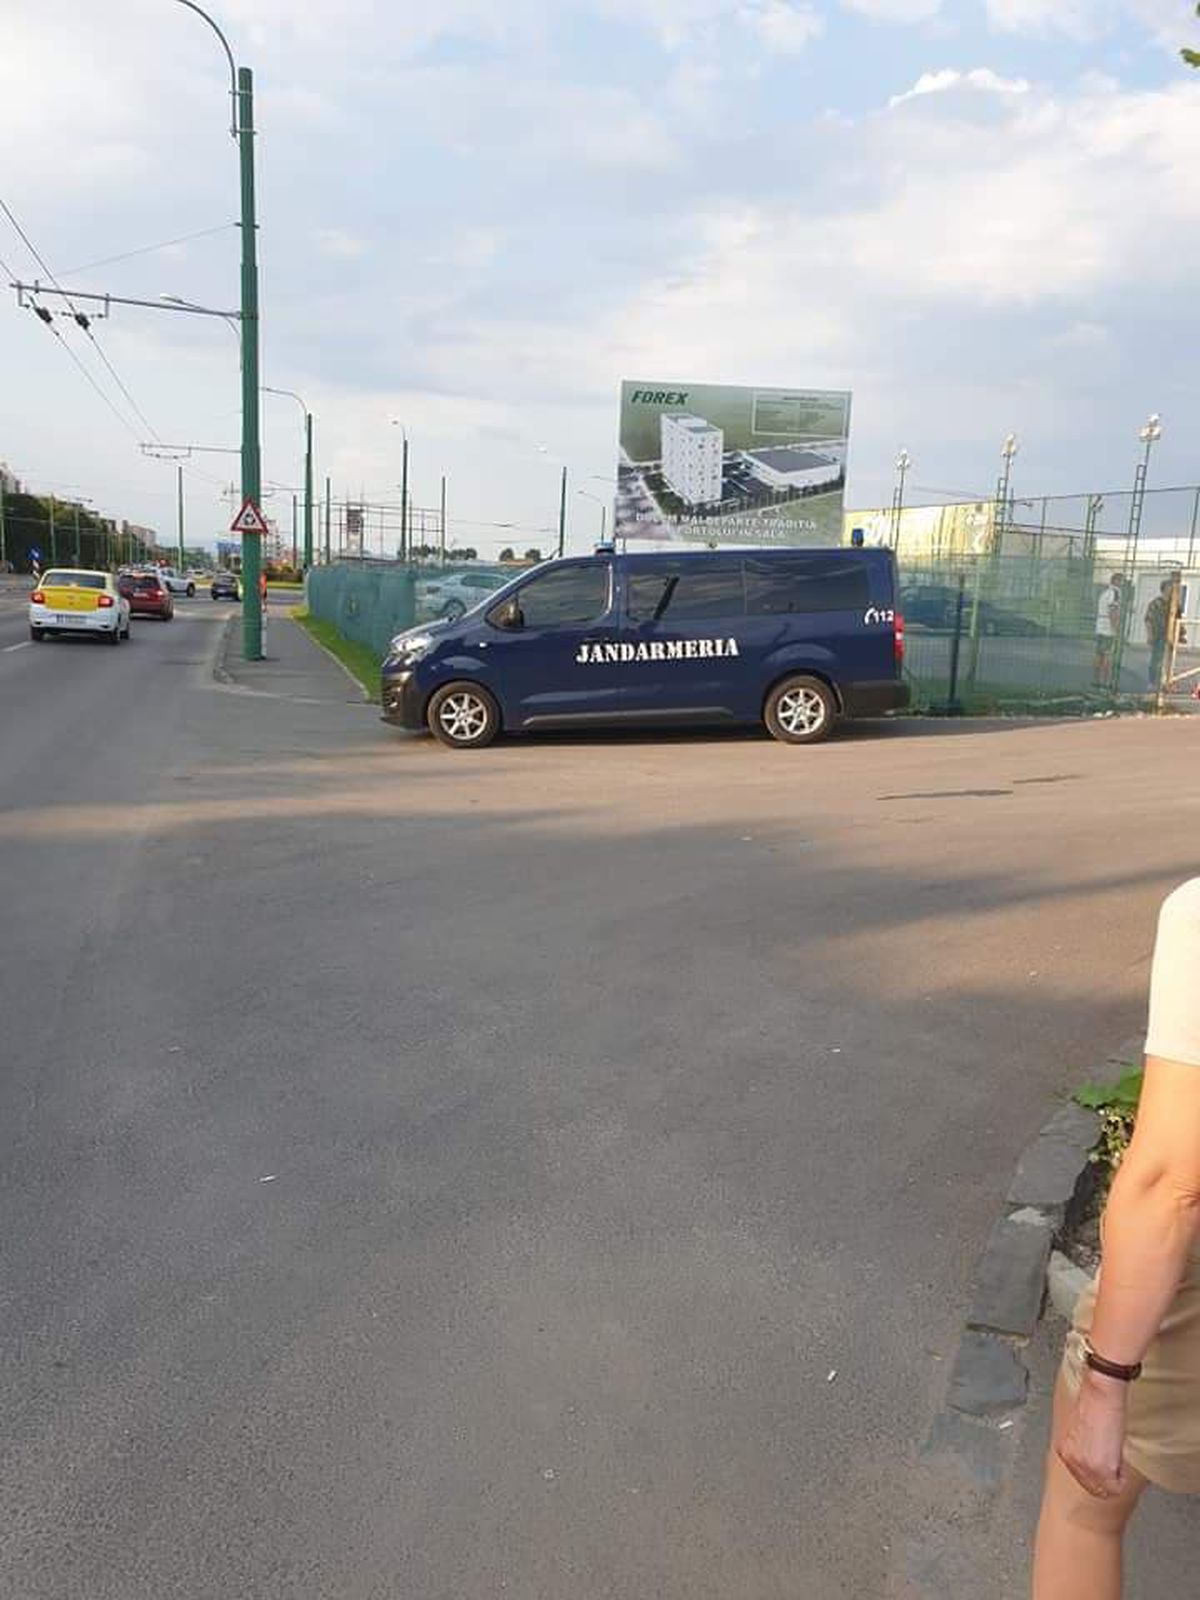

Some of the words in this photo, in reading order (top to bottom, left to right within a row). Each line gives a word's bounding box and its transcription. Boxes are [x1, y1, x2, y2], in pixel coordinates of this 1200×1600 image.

[631, 389, 689, 406] FOREX
[873, 609, 895, 623] 112
[576, 637, 740, 664] JANDARMERIA
